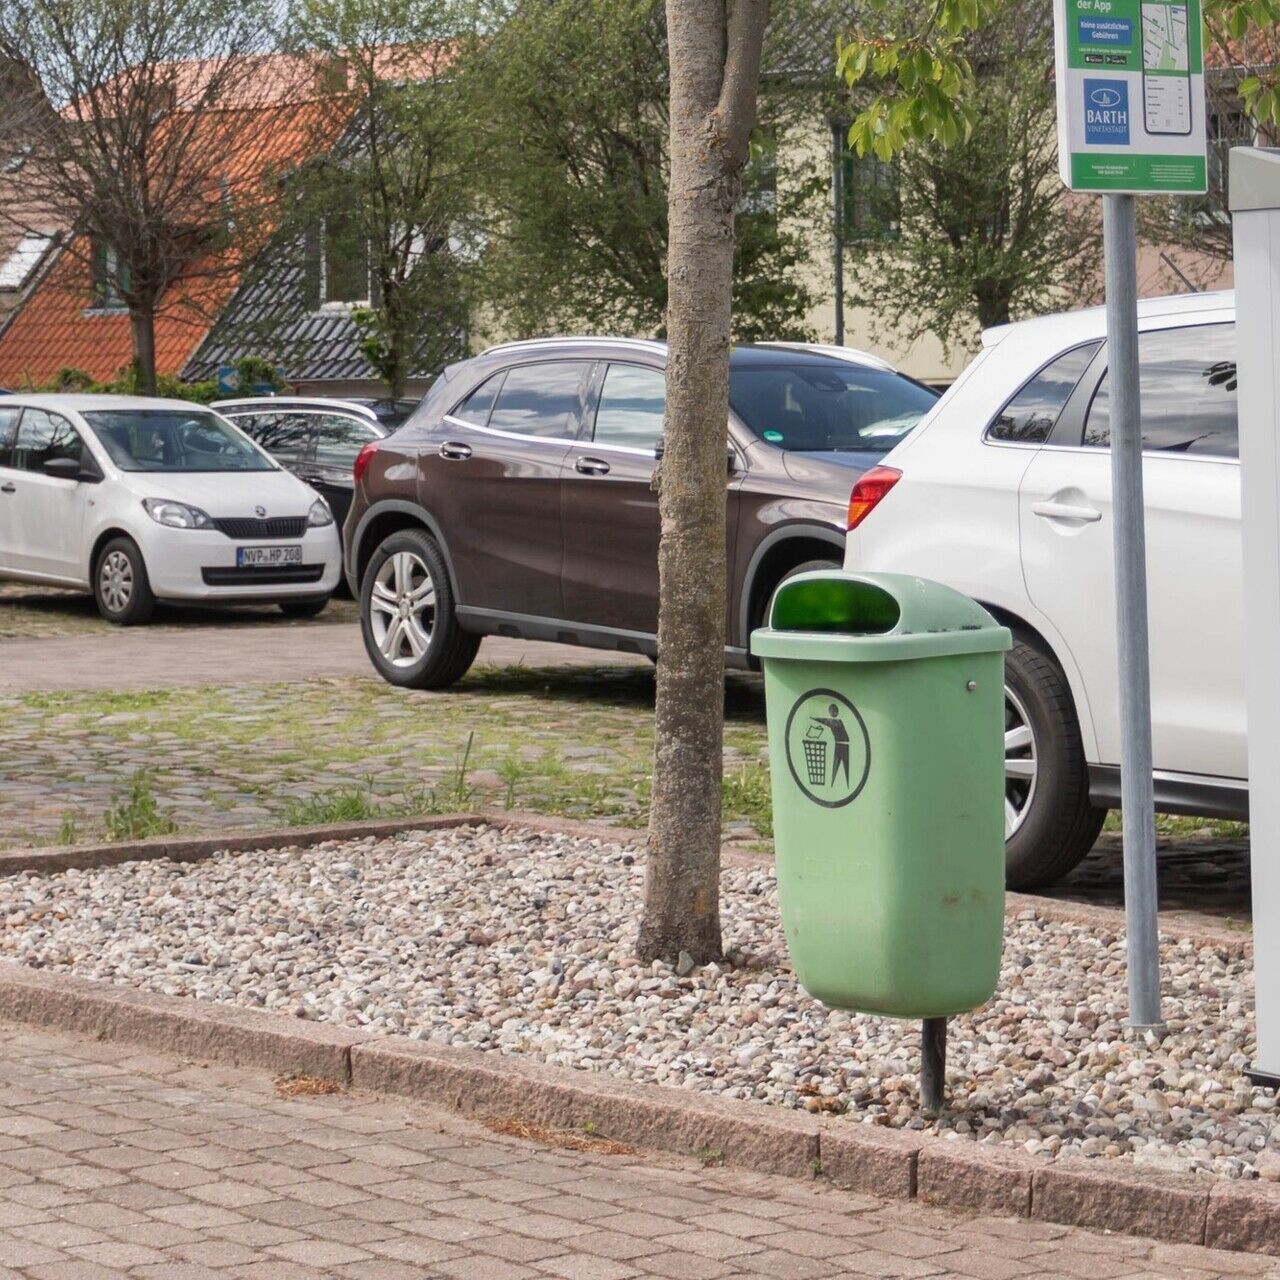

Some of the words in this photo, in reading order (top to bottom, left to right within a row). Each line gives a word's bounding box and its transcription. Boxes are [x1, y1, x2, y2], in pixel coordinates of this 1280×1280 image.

[1093, 0, 1112, 13] App
[1091, 31, 1119, 40] Gebühren
[1087, 109, 1127, 124] BARTH
[244, 550, 263, 562] NVP
